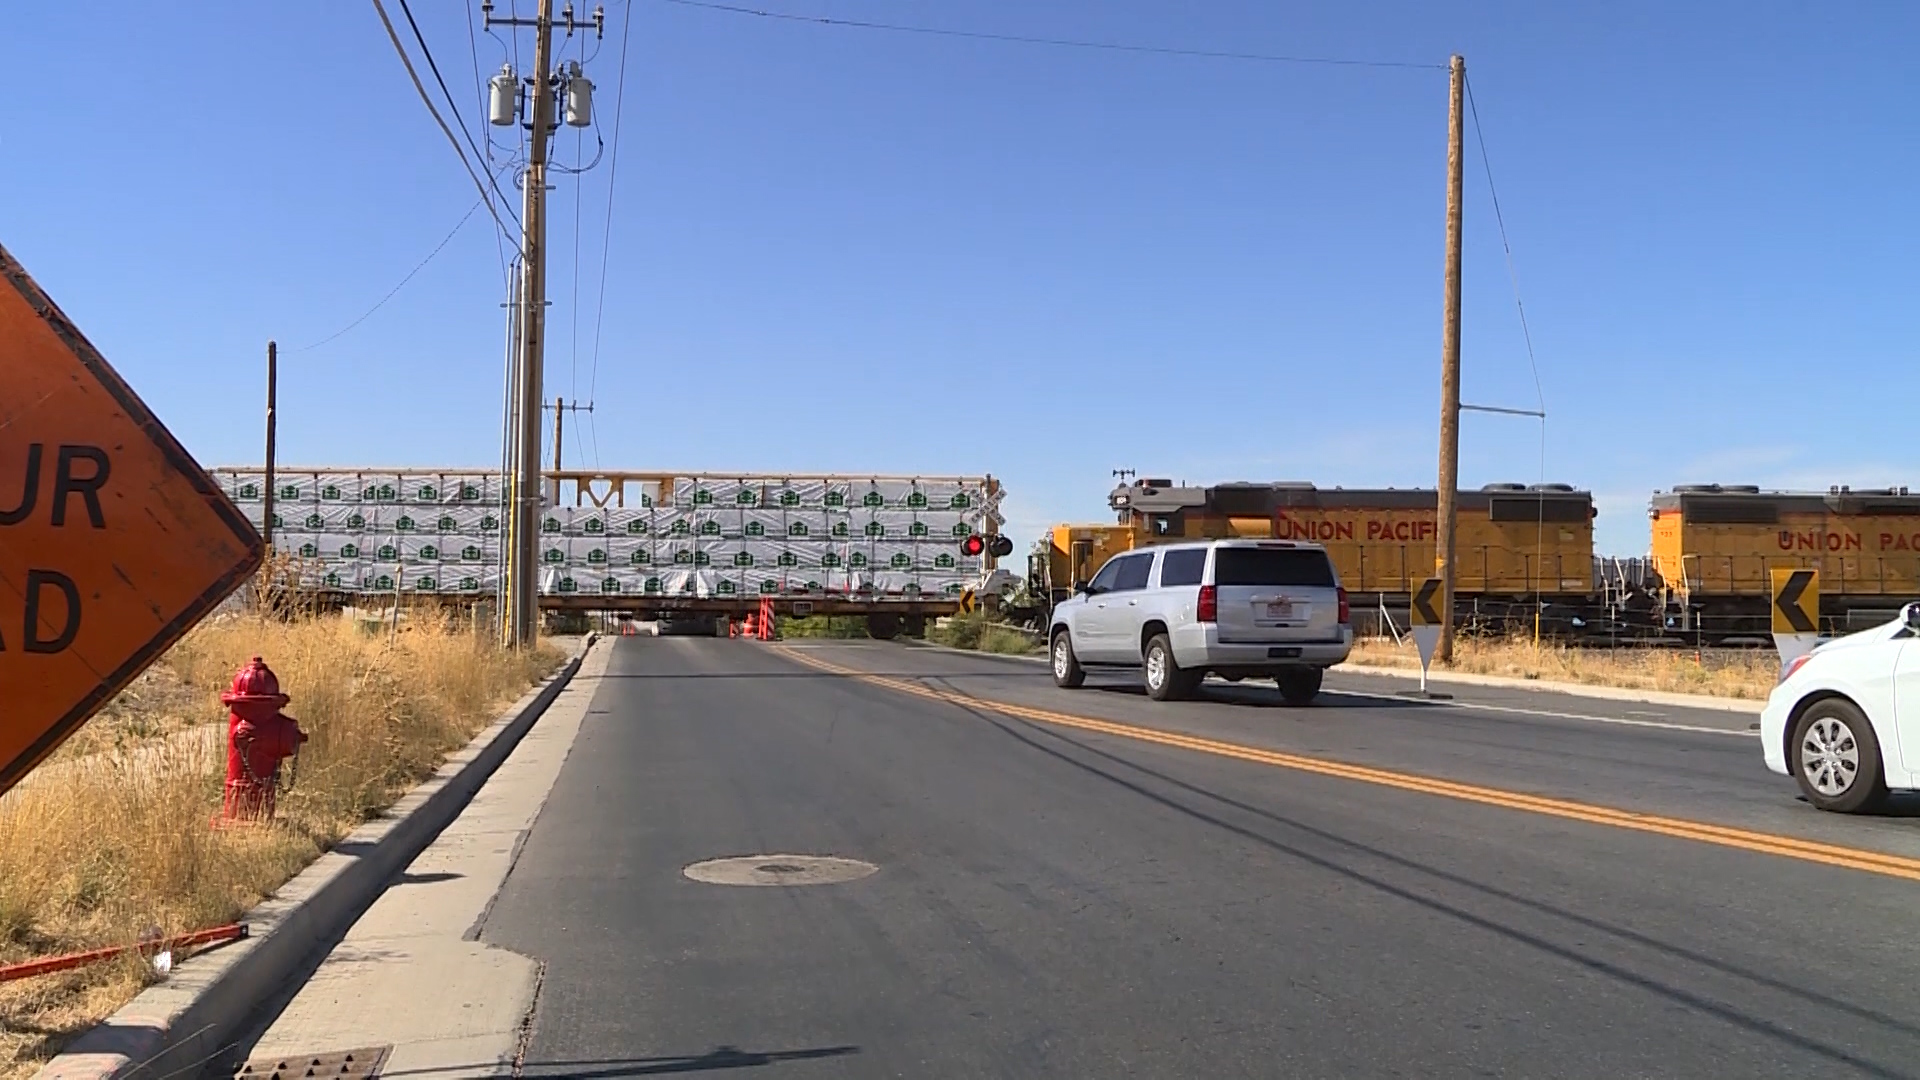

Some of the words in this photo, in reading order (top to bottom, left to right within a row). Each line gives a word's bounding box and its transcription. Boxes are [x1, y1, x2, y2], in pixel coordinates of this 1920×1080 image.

[1275, 521, 1353, 540] UNION
[1367, 521, 1438, 540] PACIFI
[1778, 531, 1862, 551] UNION
